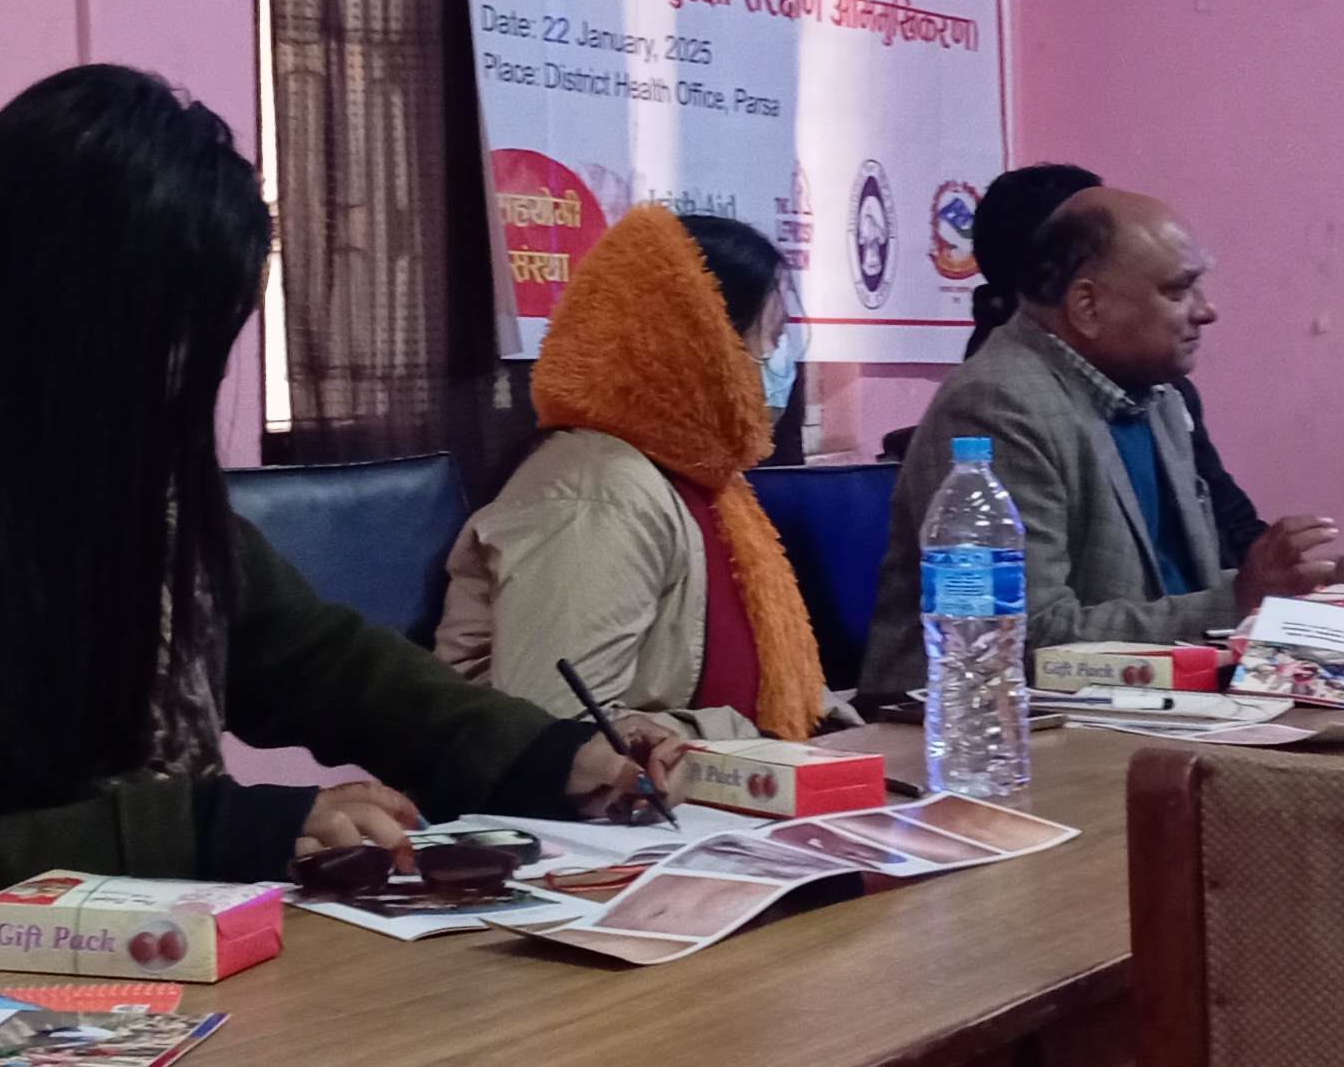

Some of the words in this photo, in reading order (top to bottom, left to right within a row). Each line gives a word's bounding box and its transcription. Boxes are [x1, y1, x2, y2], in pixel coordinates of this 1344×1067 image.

[481, 4, 536, 39] Date:
[542, 15, 570, 45] 22
[575, 21, 659, 64] January,
[665, 34, 713, 65] 2025
[482, 52, 540, 86] Place:
[544, 62, 610, 96] District
[614, 69, 671, 105] Health
[675, 80, 730, 115] Office,
[733, 87, 781, 118] Parsa
[52, 926, 116, 954] Pack
